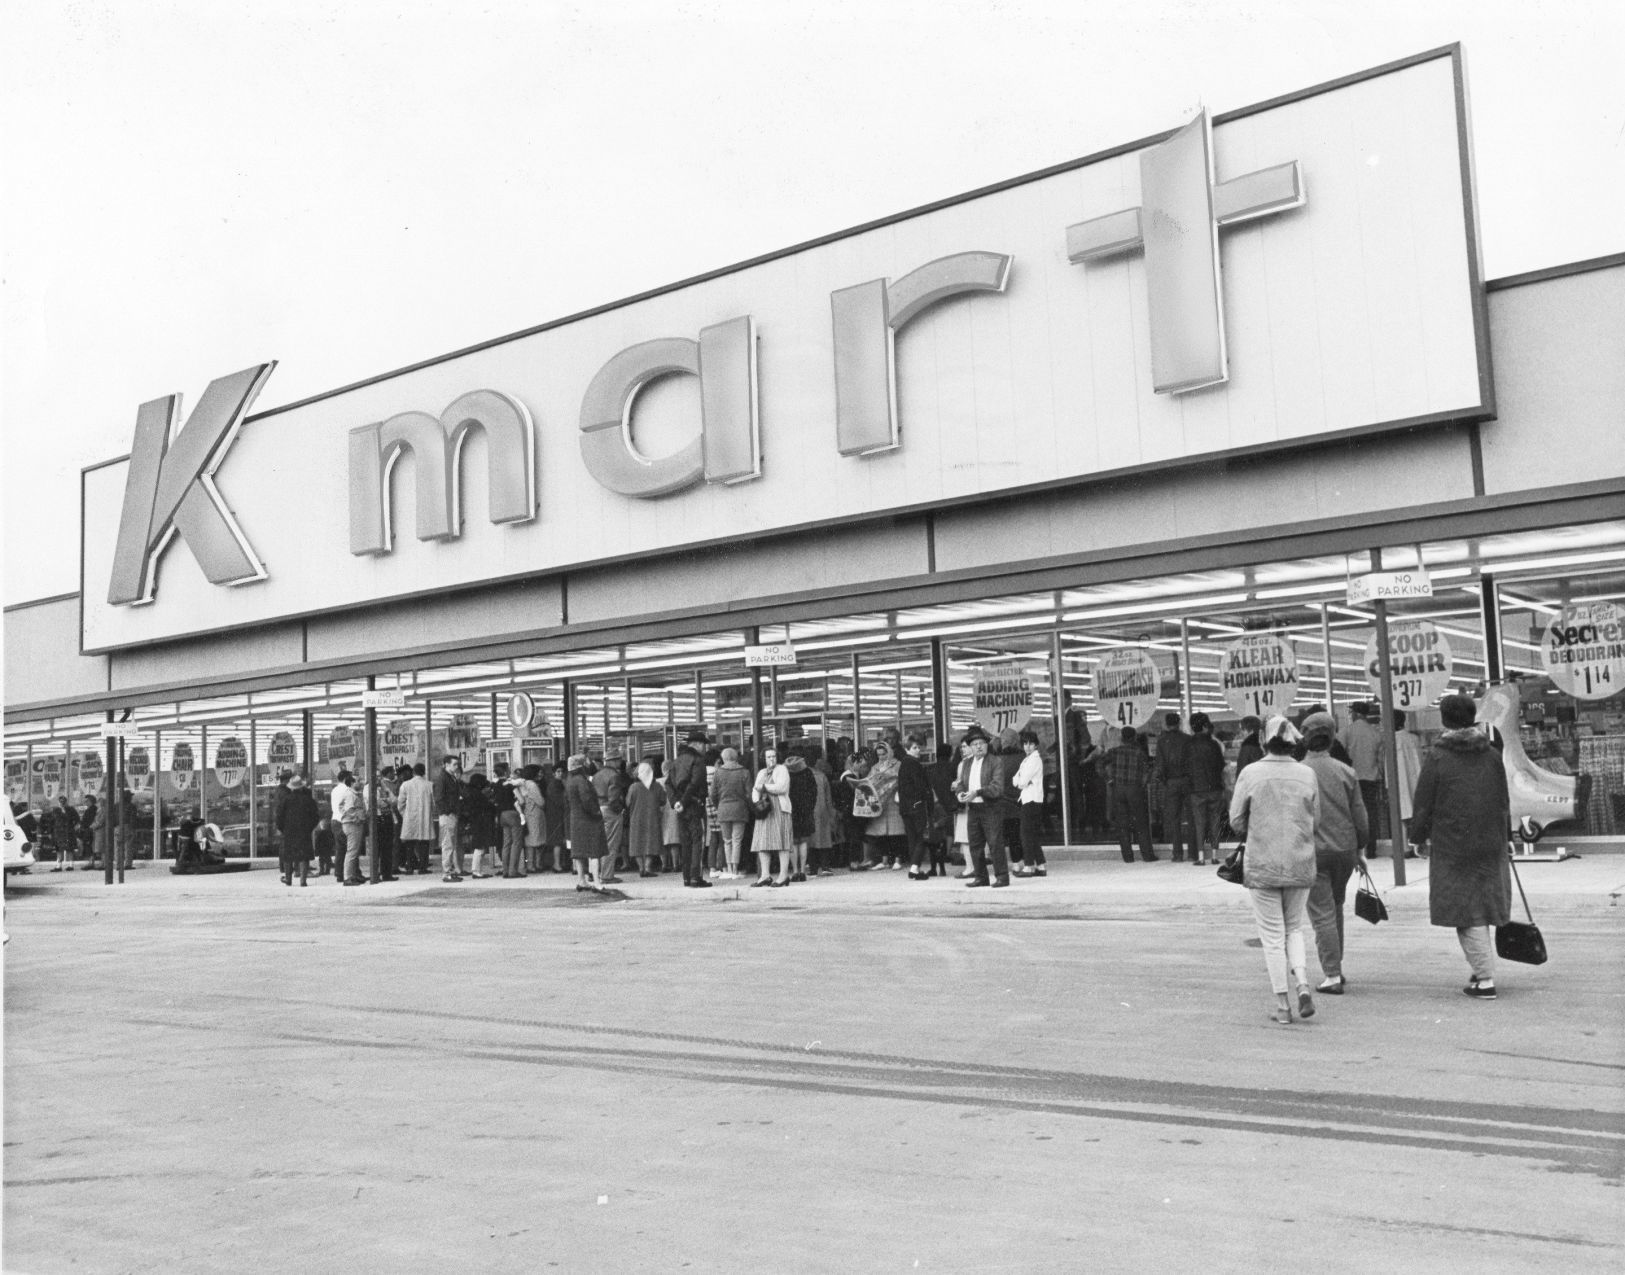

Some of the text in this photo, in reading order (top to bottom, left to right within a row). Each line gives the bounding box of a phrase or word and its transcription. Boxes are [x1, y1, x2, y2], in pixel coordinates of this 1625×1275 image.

[1394, 574, 1411, 584] NO
[1377, 585, 1430, 597] PARKING
[1376, 631, 1439, 655] COOP
[766, 646, 779, 655] NO
[751, 655, 794, 664] PARKING
[1229, 646, 1284, 669] KLEAR
[978, 678, 1030, 694] ADDING
[380, 691, 391, 699] NO
[976, 692, 1032, 709] MACHINE
[367, 698, 403, 706] PARKING
